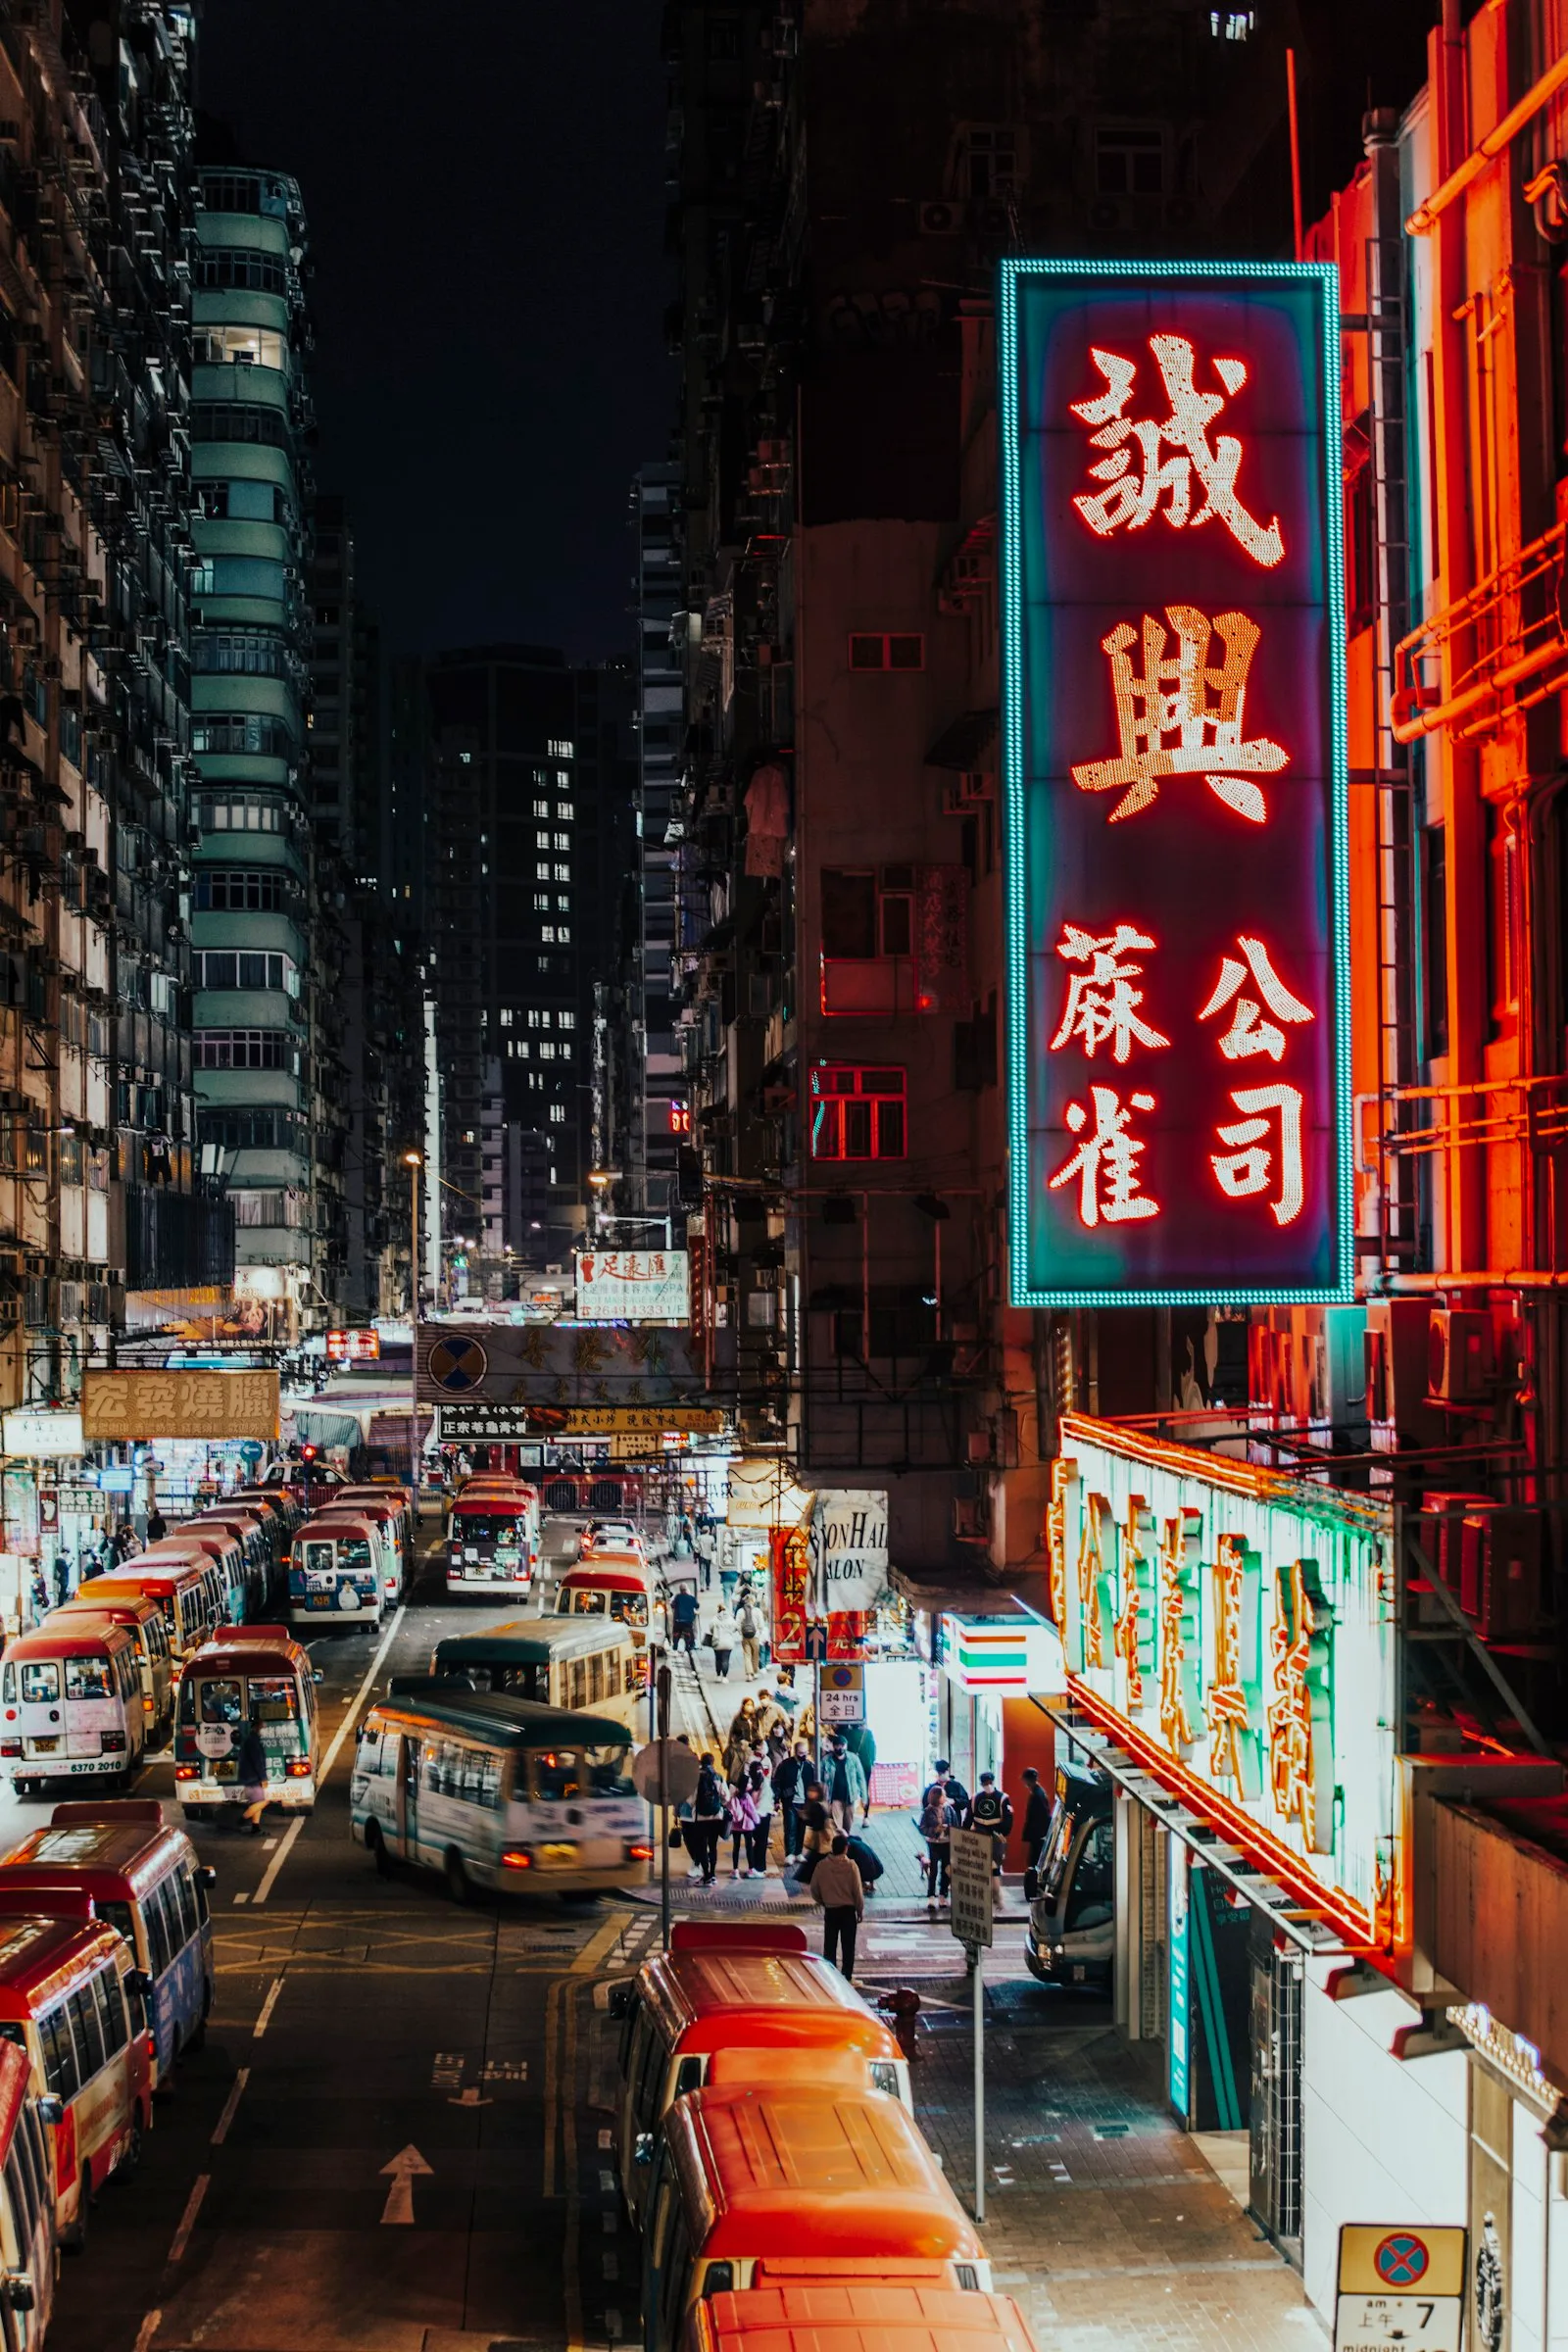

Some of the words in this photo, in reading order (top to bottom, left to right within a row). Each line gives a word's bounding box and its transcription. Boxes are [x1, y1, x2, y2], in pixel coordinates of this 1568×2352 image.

[1070, 333, 1291, 824] 誠興
[1196, 935, 1316, 1226] 公司
[825, 1692, 840, 1702] 24
[842, 1692, 858, 1702] hrs
[829, 1704, 855, 1717] 全日
[71, 1764, 95, 1773] 6370
[97, 1760, 122, 1772] 2010
[1357, 2312, 1395, 2328] 上午
[1366, 2299, 1387, 2309] am
[1415, 2303, 1436, 2329] 7
